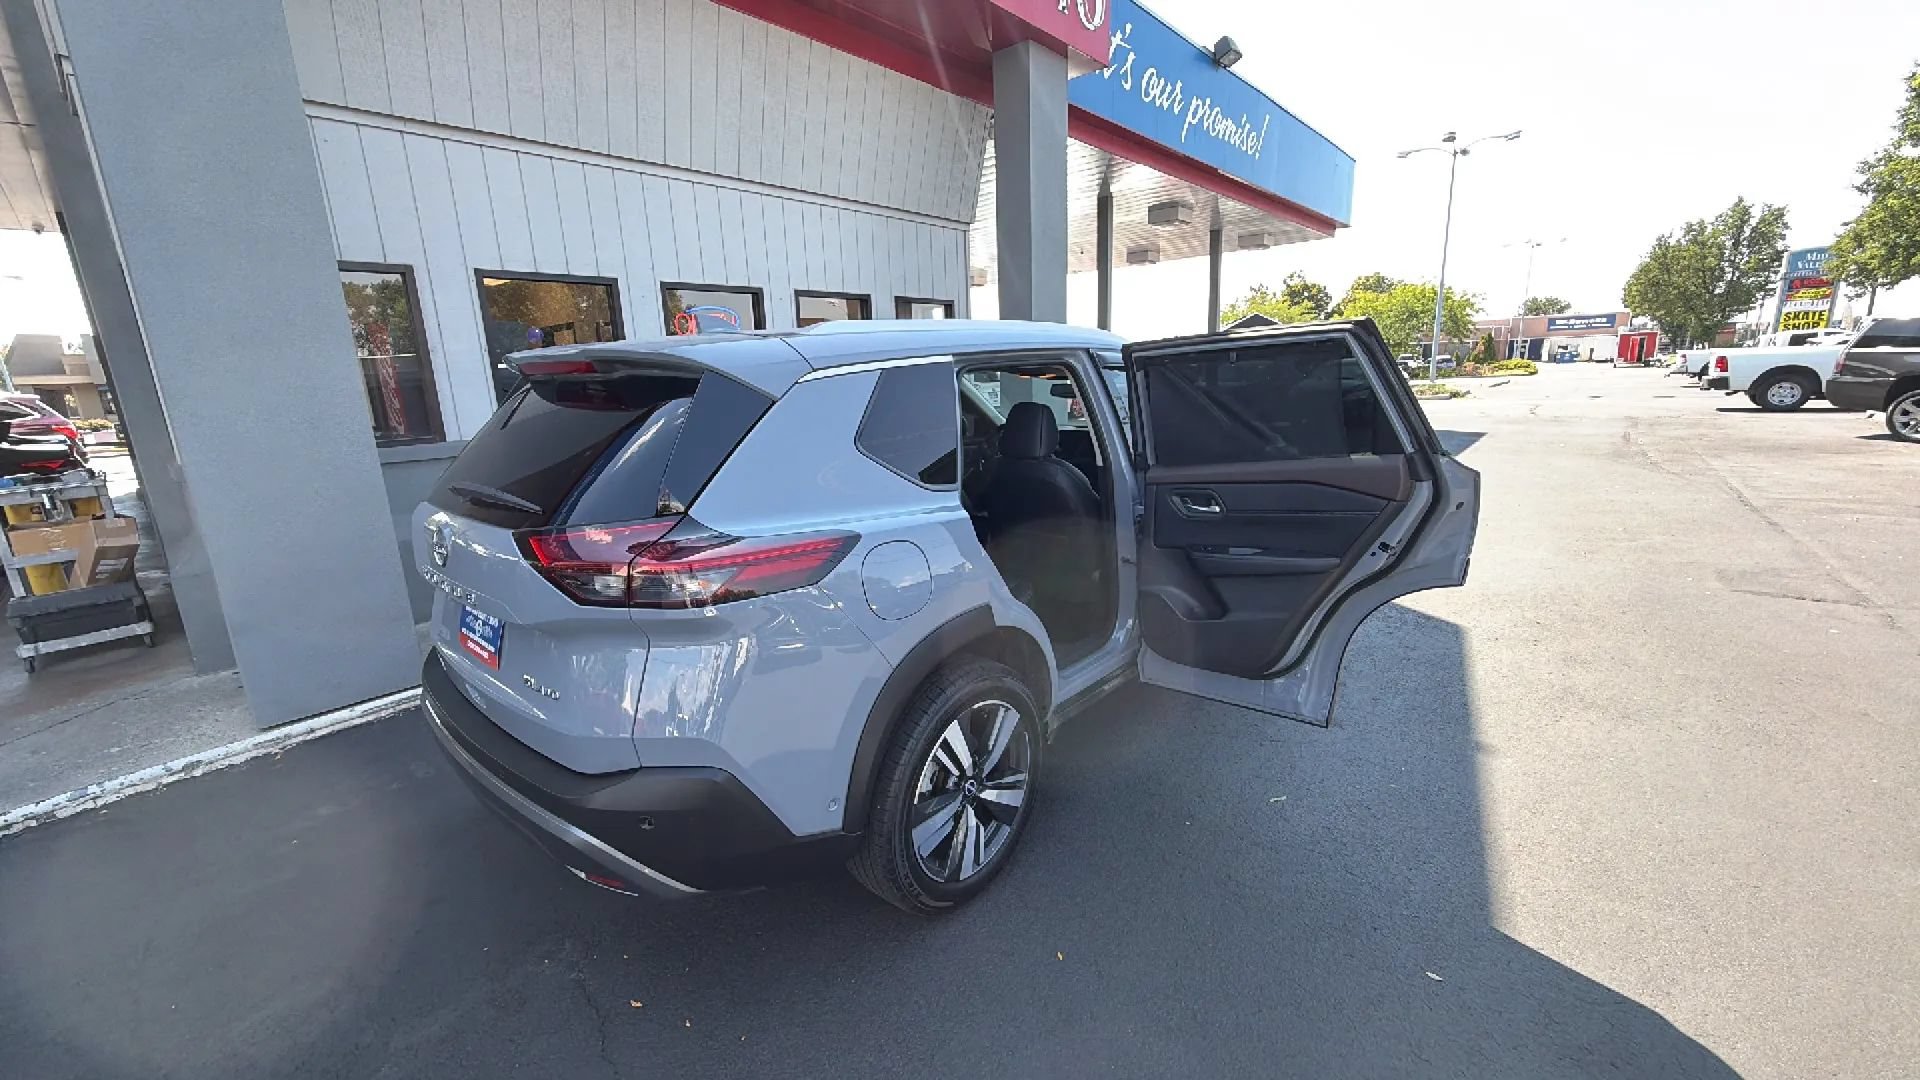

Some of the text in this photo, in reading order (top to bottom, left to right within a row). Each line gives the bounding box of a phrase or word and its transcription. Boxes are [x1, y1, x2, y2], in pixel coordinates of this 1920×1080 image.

[1141, 67, 1184, 115] our
[1181, 95, 1270, 160] promise!
[1784, 310, 1826, 322] SKATE
[1782, 321, 1821, 332] SHOP
